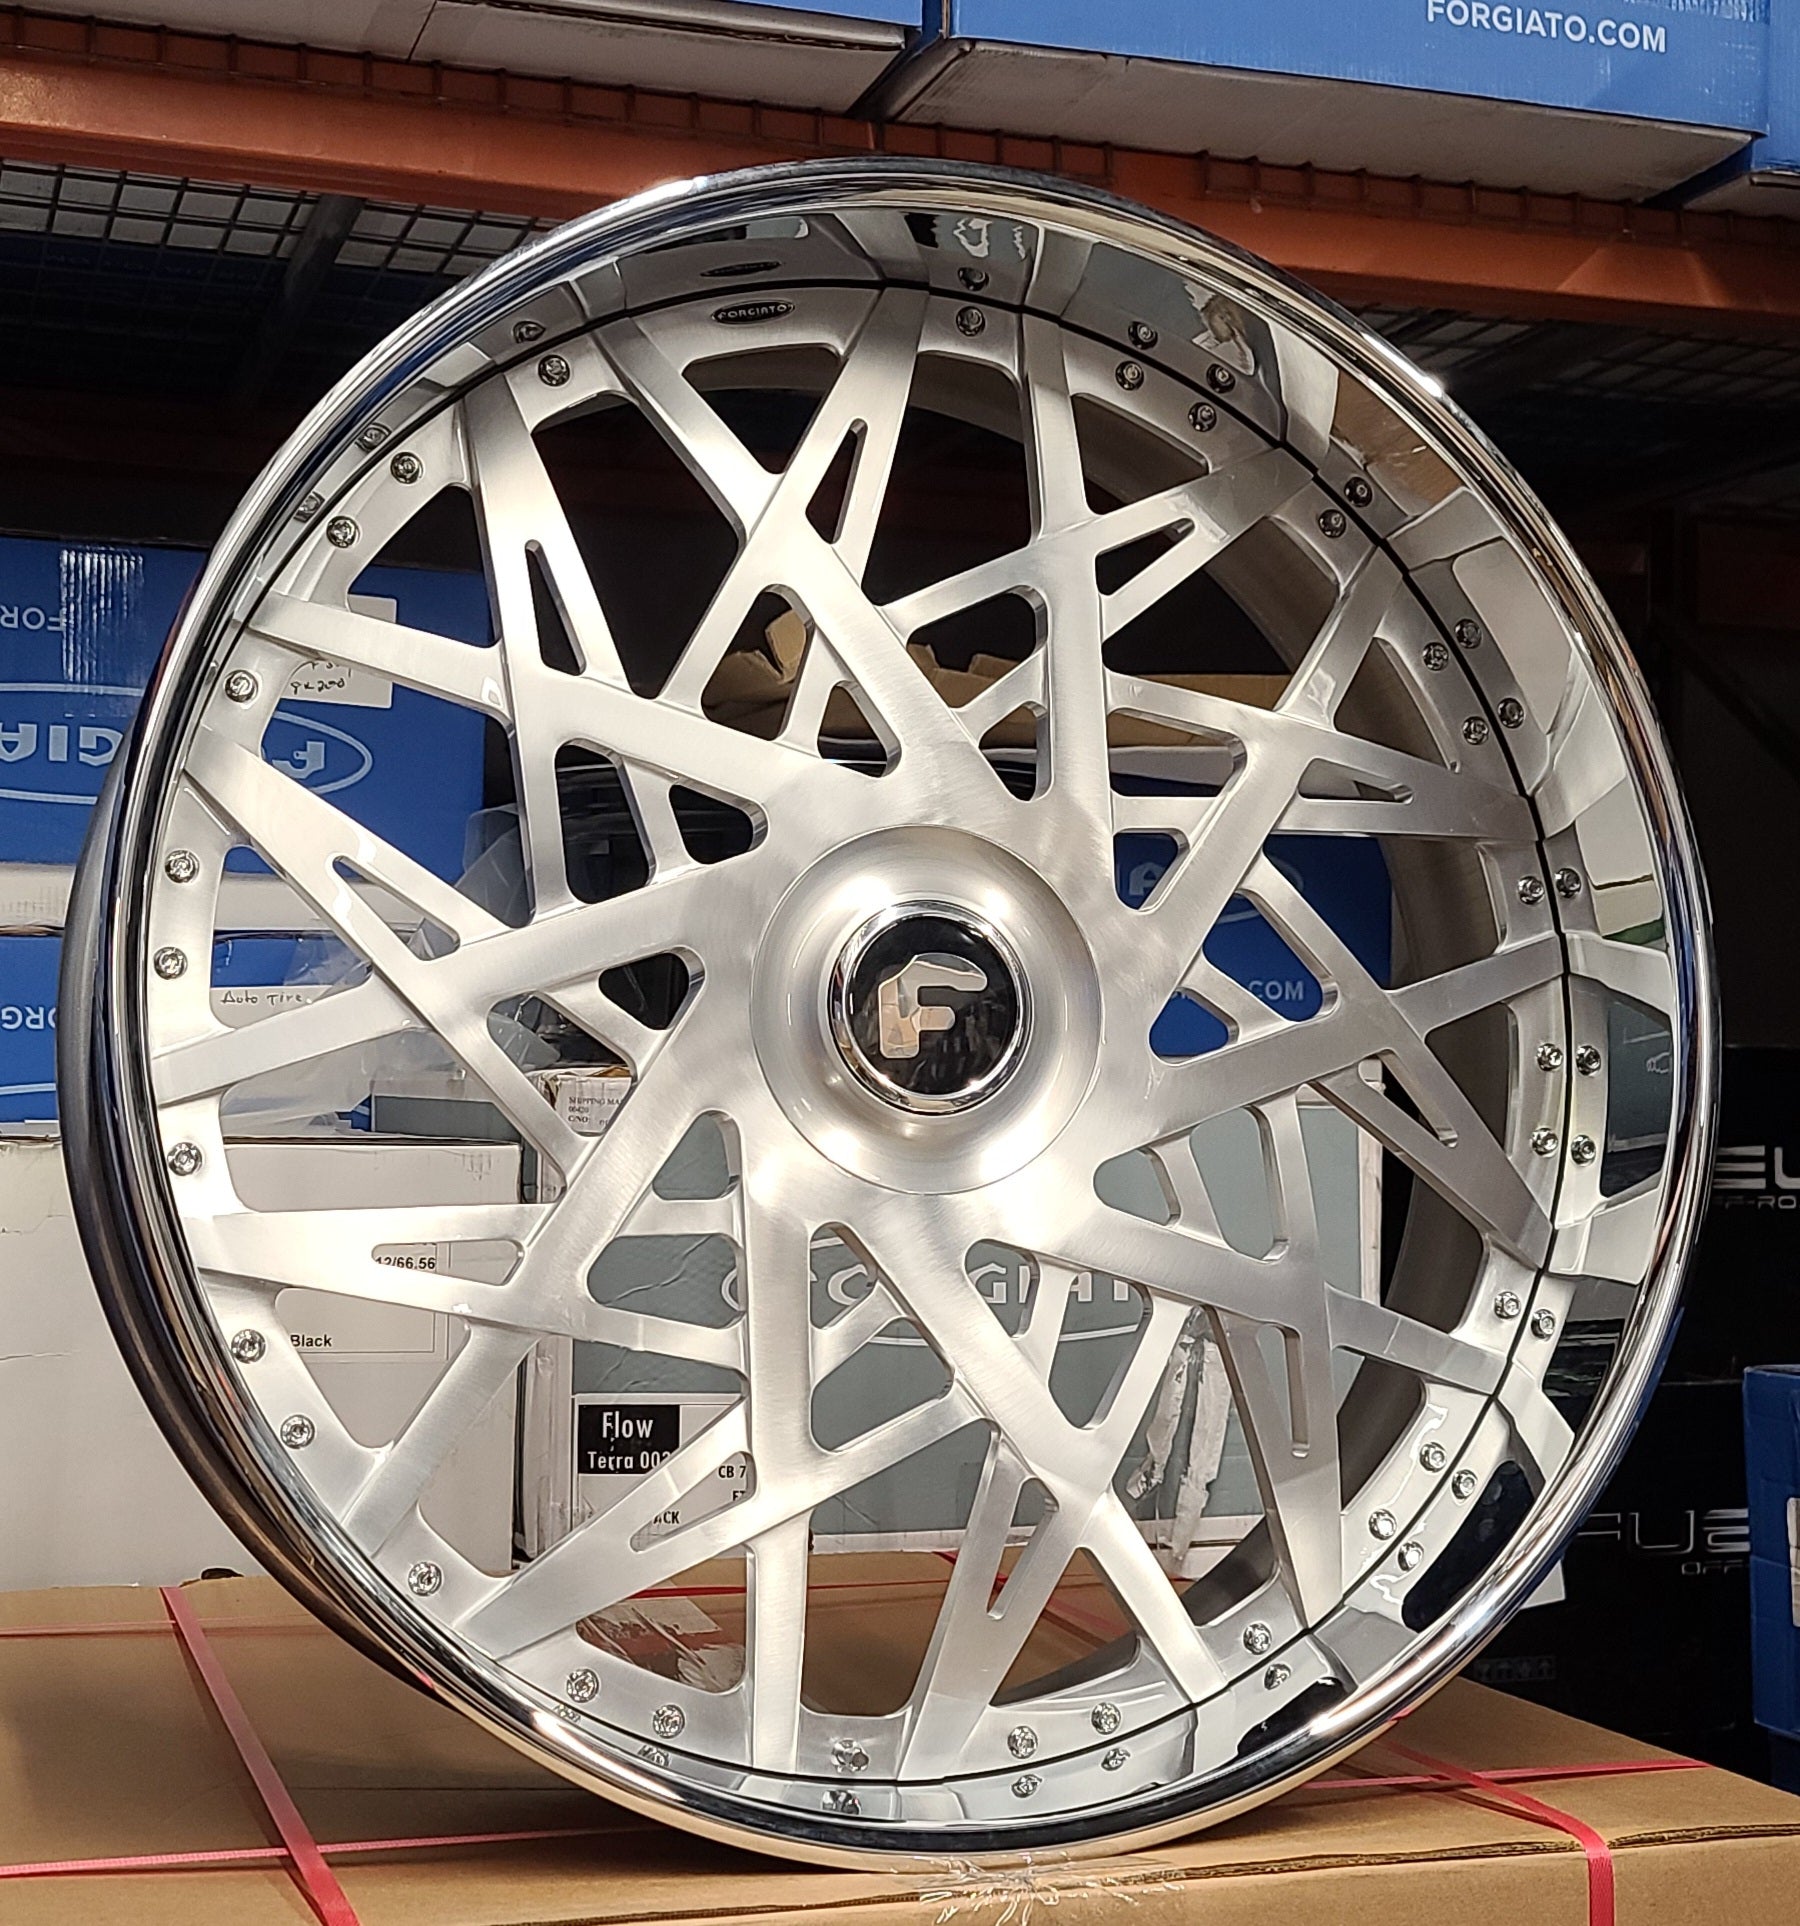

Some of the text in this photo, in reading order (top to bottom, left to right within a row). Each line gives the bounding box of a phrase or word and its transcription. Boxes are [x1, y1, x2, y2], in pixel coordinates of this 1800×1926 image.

[1427, 0, 1666, 53] FORGIATO.COM
[717, 304, 788, 321] FORGIATO
[290, 1334, 332, 1347] Black
[602, 1411, 653, 1438] Flow
[587, 1451, 634, 1471] Terra
[718, 1465, 734, 1478] CB
